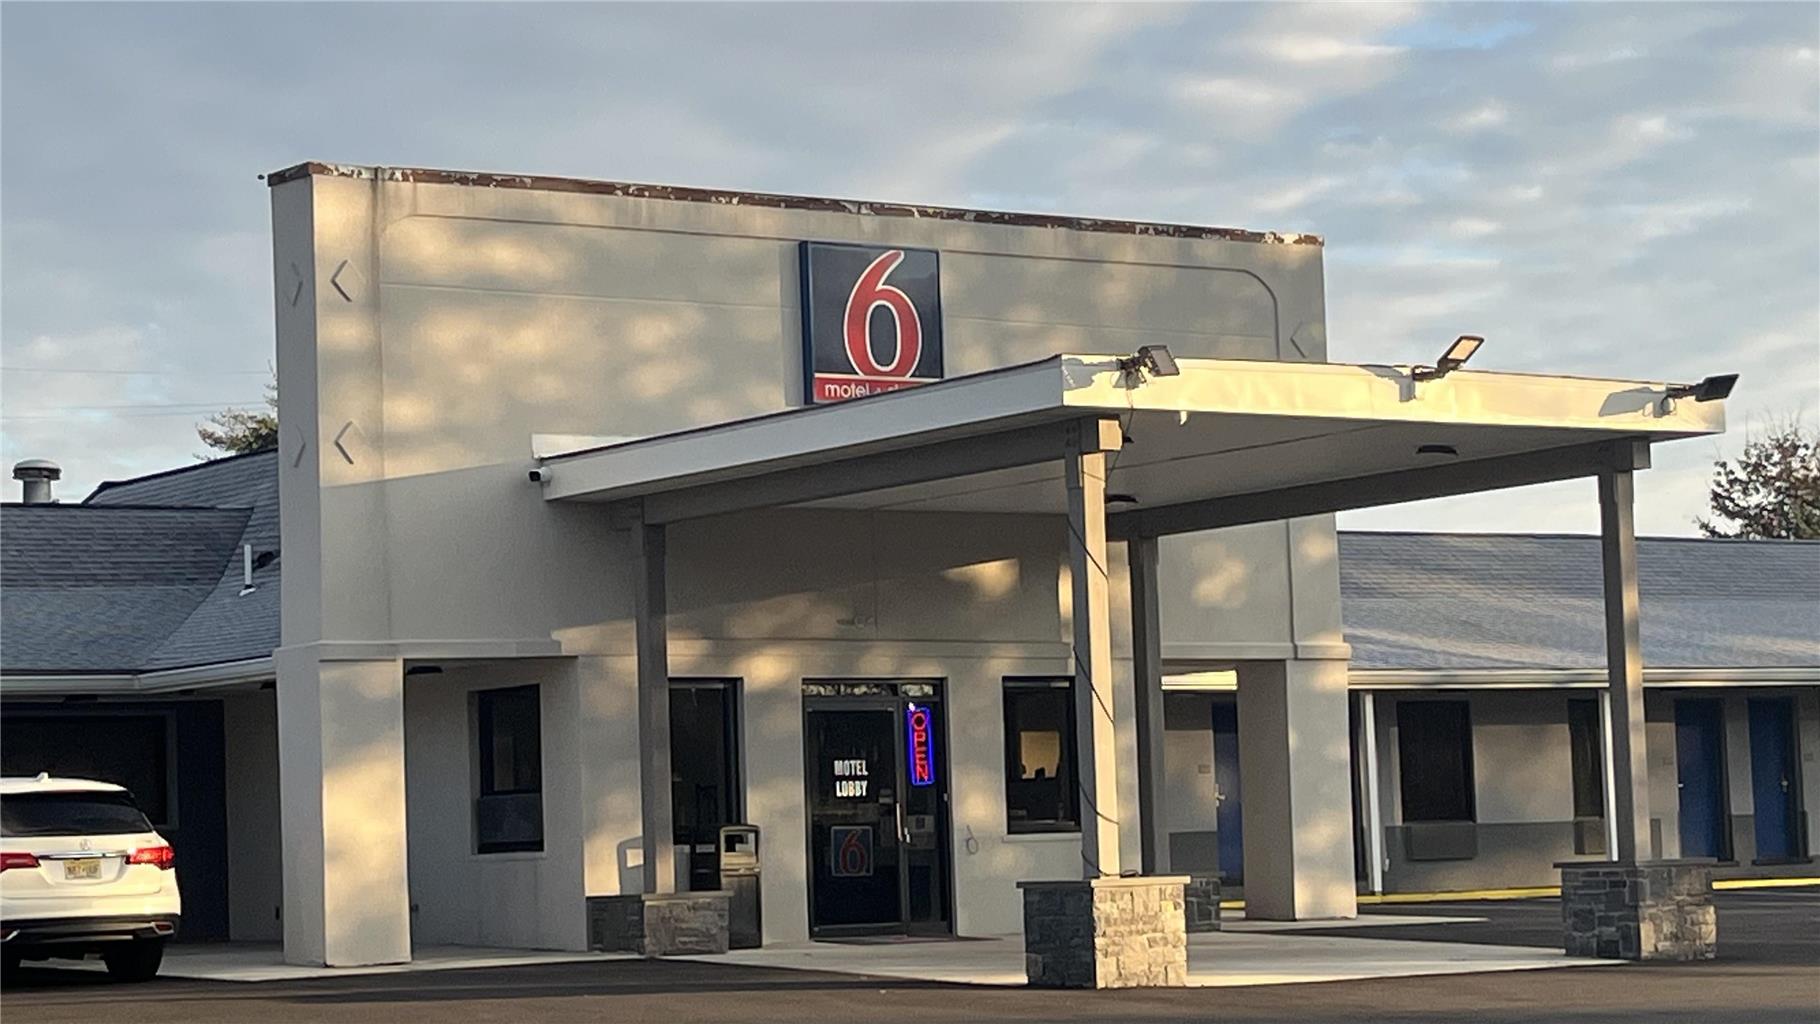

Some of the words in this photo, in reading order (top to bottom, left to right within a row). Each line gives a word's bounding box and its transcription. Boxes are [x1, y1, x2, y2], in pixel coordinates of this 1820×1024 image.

[843, 249, 923, 378] 6
[824, 382, 870, 399] motel
[911, 712, 929, 784] OPEN
[833, 759, 869, 776] MOTEL
[836, 780, 868, 797] LOBBY
[839, 829, 867, 875] 6
